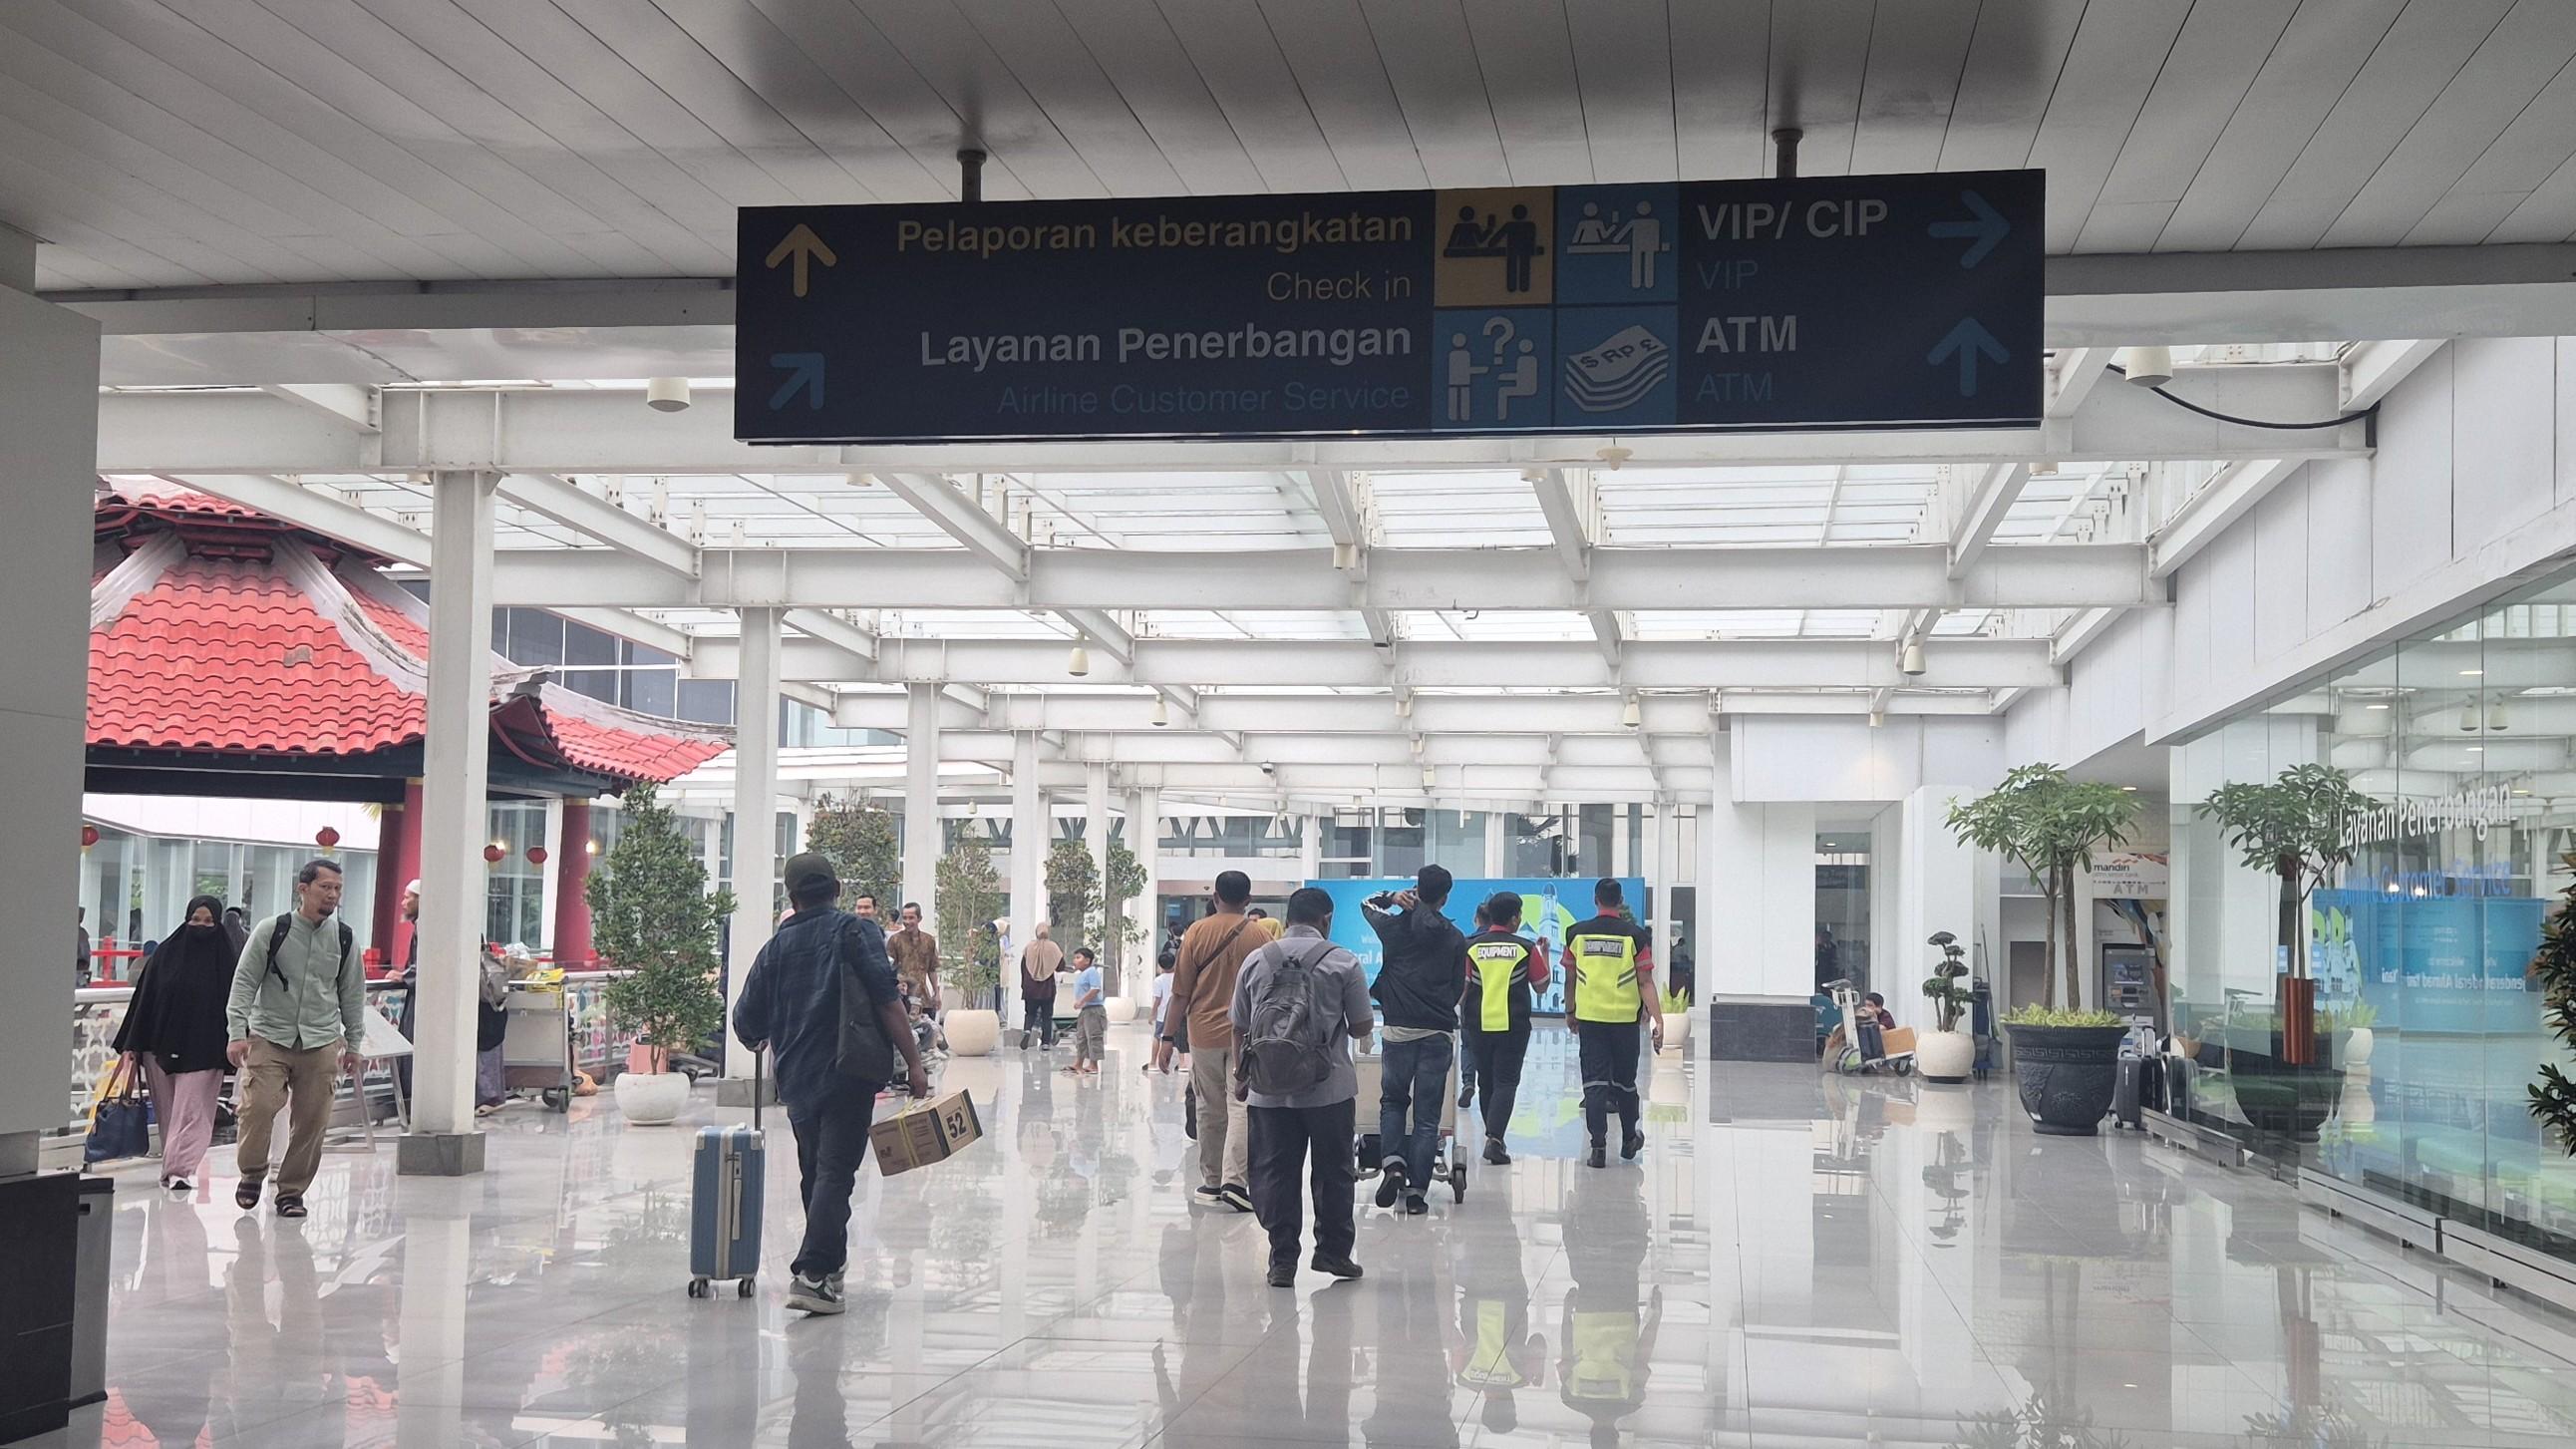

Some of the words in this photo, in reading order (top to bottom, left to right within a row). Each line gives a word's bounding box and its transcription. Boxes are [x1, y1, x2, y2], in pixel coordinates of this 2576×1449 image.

[897, 218, 1097, 258] Pelaporan
[1112, 212, 1412, 252] keberangkatan
[1698, 200, 1792, 239] VIP/
[1806, 198, 1888, 238] CIP
[1267, 270, 1373, 302] Check
[1384, 268, 1412, 302] in
[1697, 259, 1759, 289] VIP
[920, 329, 1101, 373] Layanan
[1118, 321, 1412, 366] Penerbangan
[1696, 314, 1797, 353] ATM
[997, 385, 1099, 415] Airline
[1112, 382, 1271, 415] Customer
[1282, 380, 1410, 411] Service
[1696, 371, 1772, 403] ATM
[2339, 805, 2395, 859] Layanan
[2399, 783, 2511, 842] Penerbangan
[2113, 884, 2149, 895] ATM
[1477, 945, 1517, 959] EQUIPMENT
[946, 1112, 967, 1139] 52
